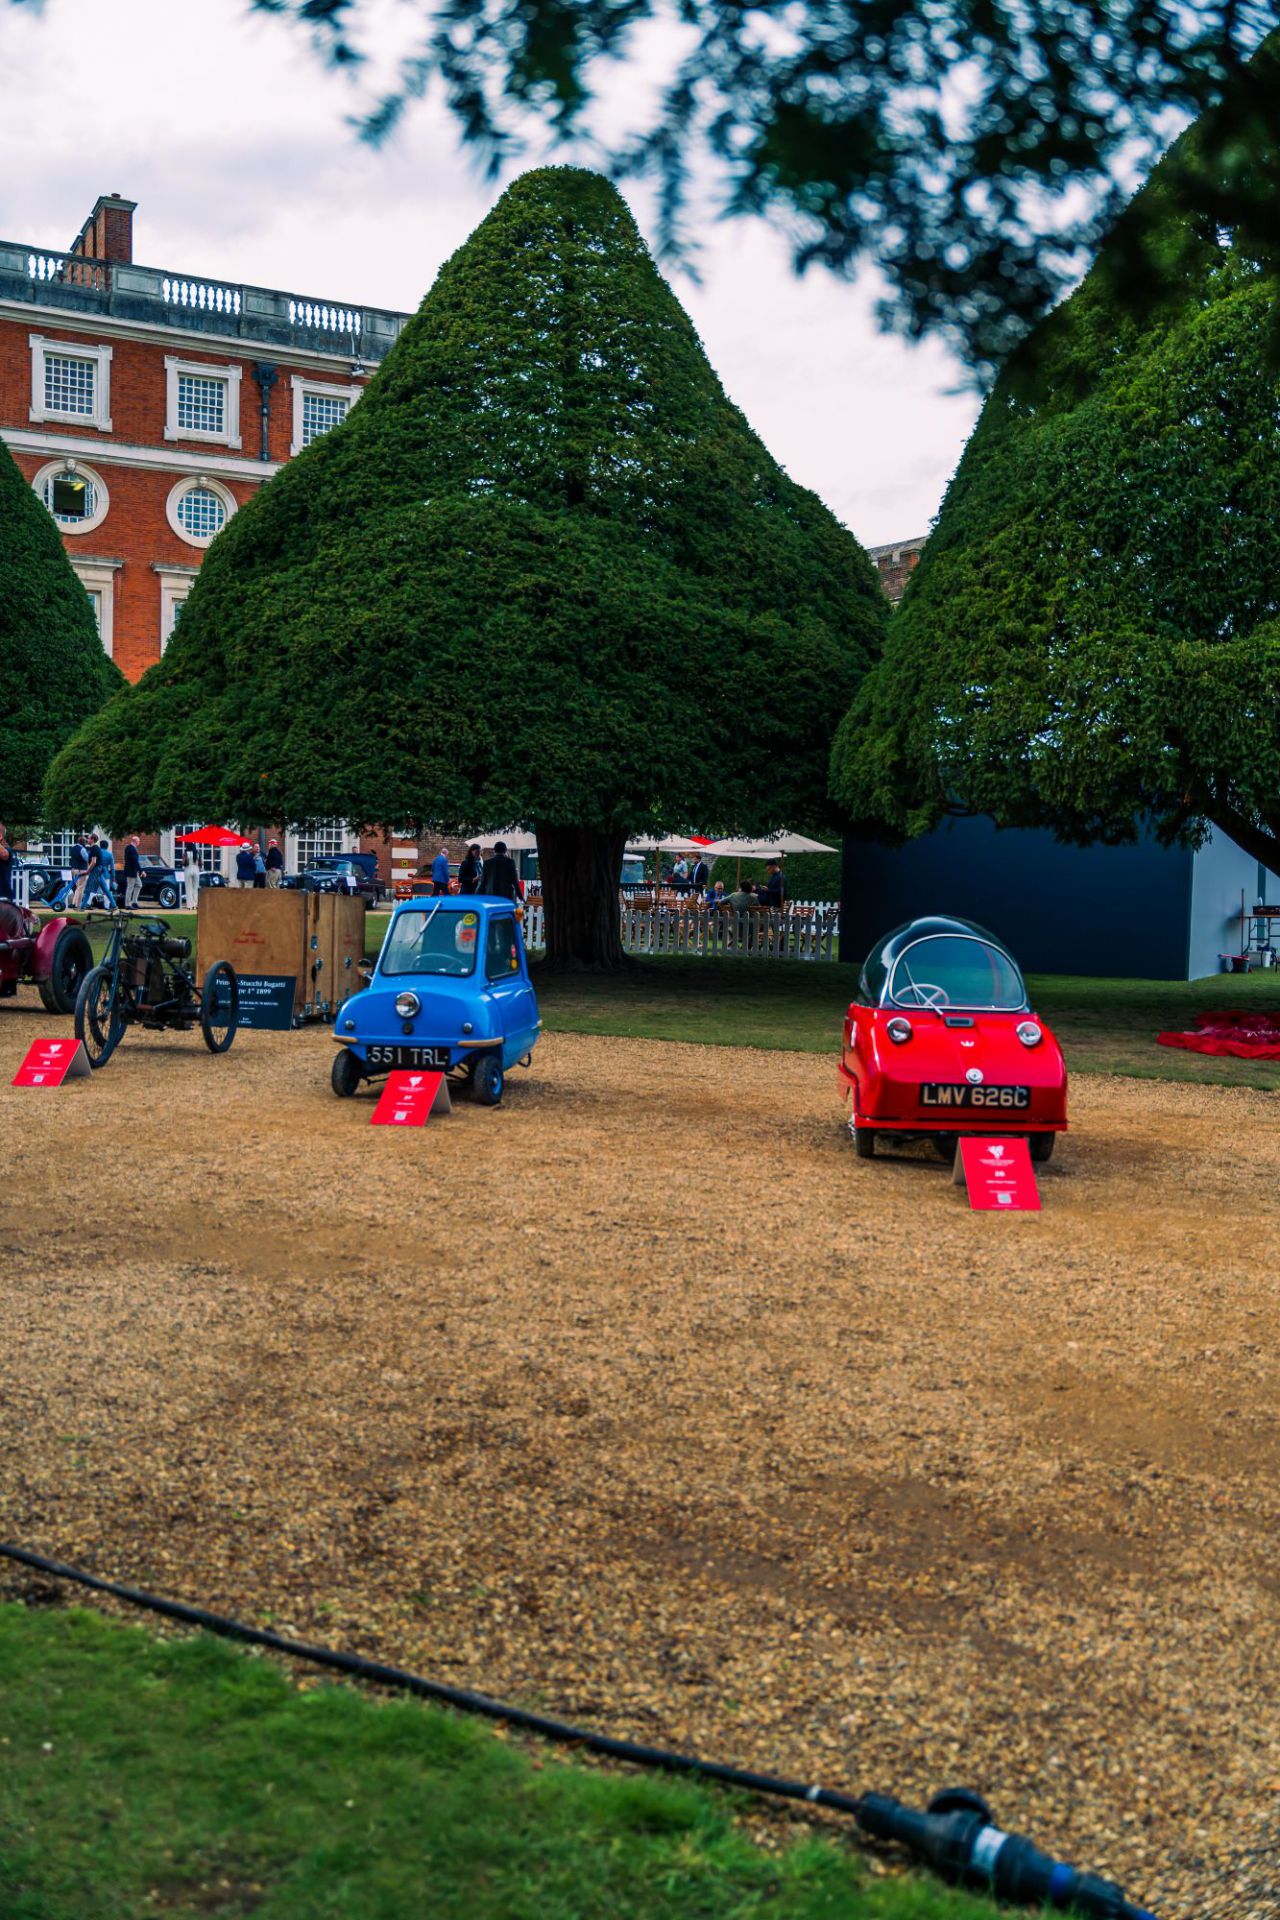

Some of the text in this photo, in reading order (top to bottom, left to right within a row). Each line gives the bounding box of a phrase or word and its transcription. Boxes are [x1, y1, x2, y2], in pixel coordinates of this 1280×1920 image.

[263, 981, 286, 989] Bugatti
[370, 1046, 446, 1065] 551 TRL
[923, 1085, 1028, 1107] LMV 626C
